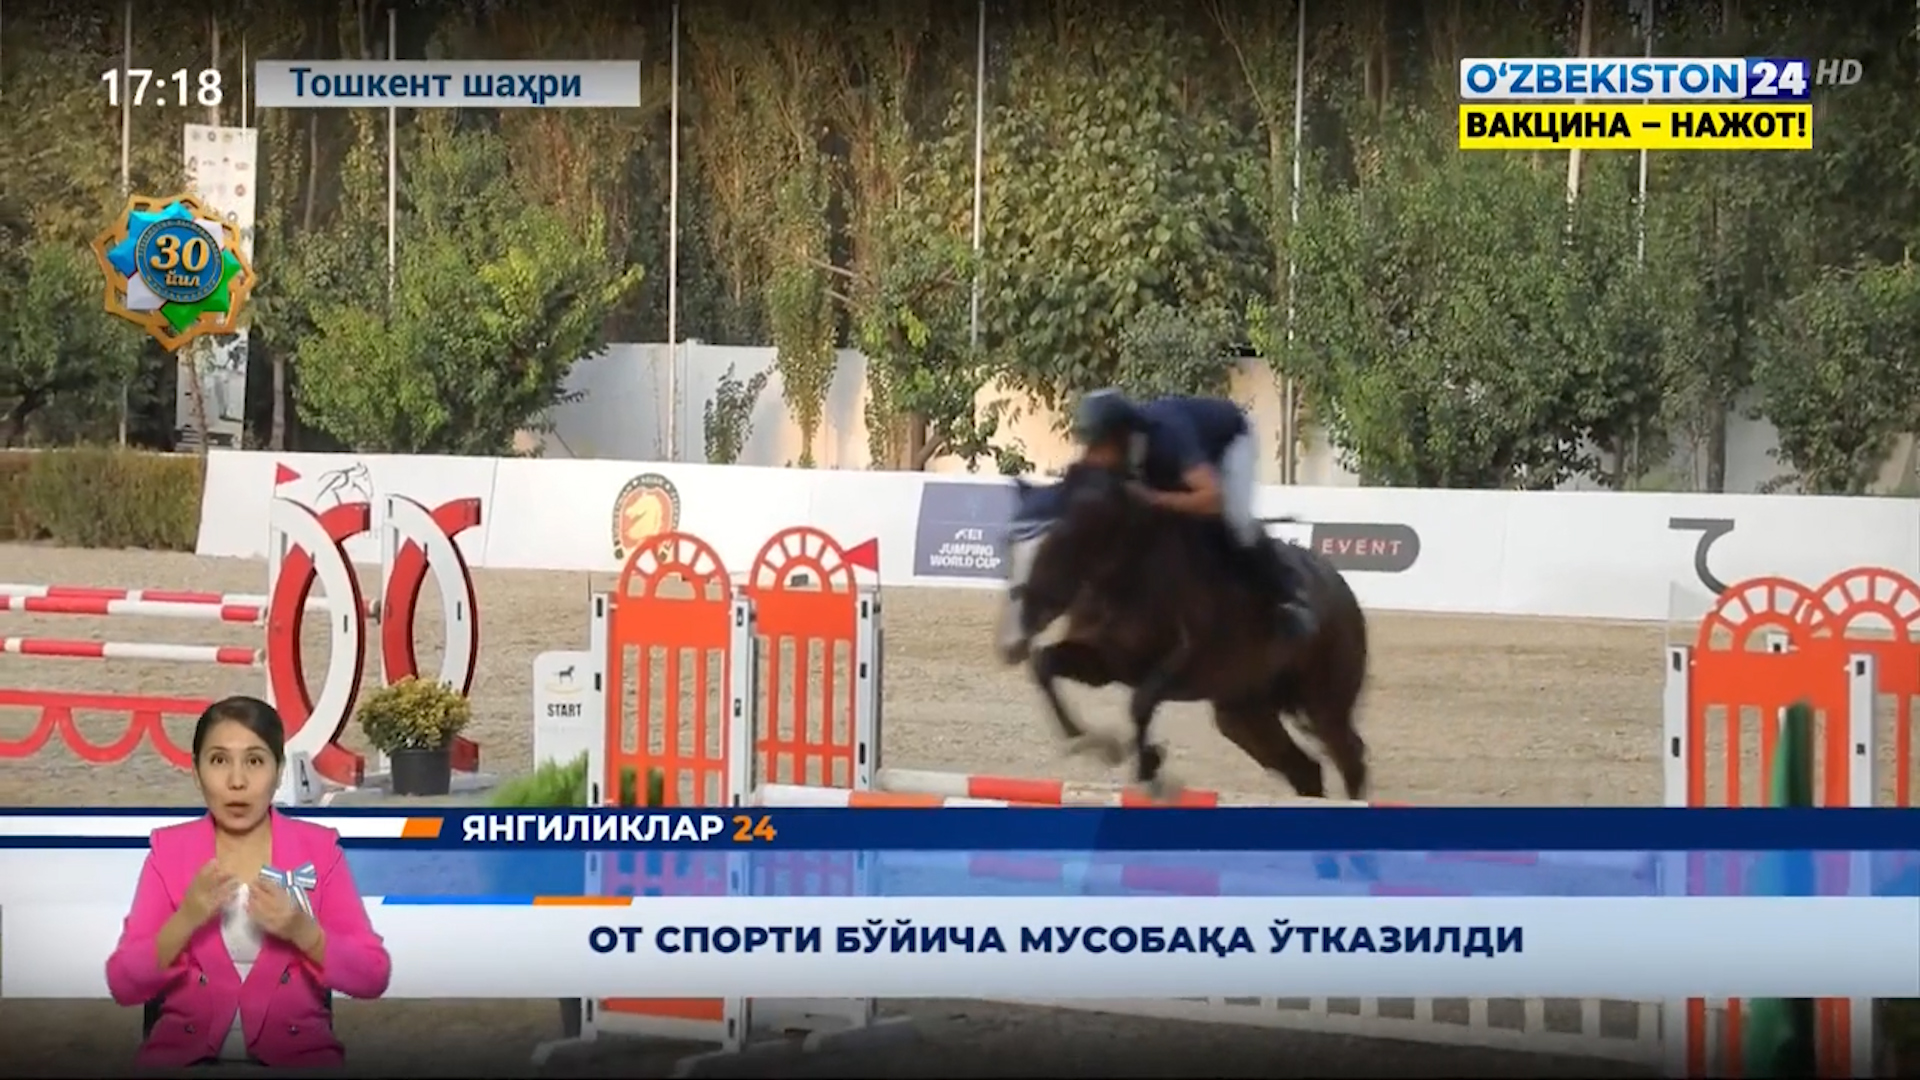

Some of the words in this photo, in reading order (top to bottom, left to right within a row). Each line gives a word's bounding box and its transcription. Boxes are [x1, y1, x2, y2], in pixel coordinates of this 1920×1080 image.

[938, 543, 994, 557] JUMPING
[1321, 537, 1402, 556] EVENT
[929, 553, 974, 568] WORLD
[975, 555, 1001, 569] CUP
[547, 703, 582, 717] START
